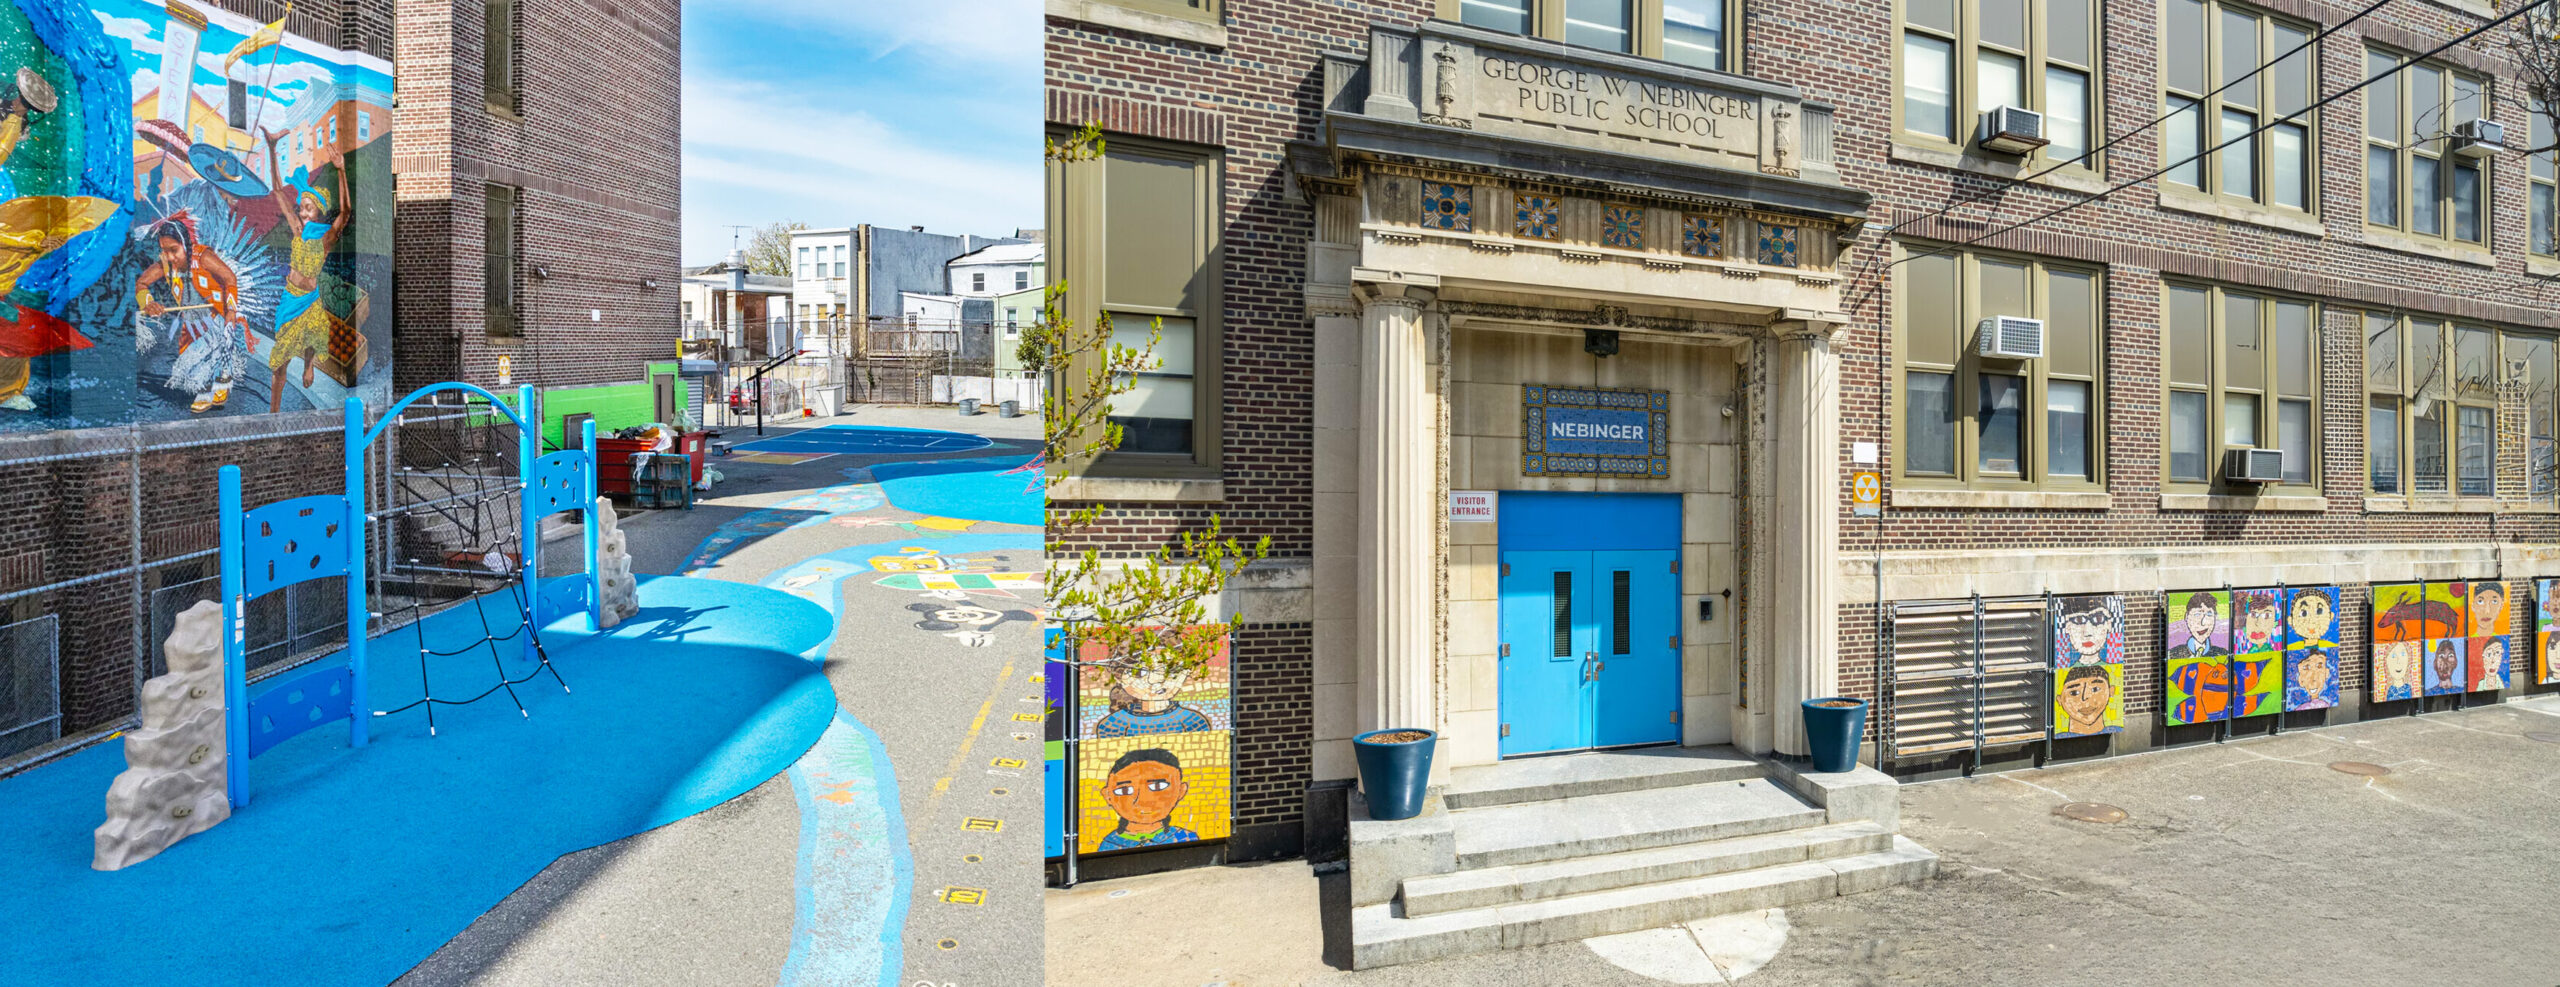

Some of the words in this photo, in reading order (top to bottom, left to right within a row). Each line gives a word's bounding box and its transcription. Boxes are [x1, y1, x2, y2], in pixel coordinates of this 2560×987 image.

[1482, 56, 1588, 93] GEORGE
[1600, 76, 1629, 98] W
[1640, 81, 1754, 121] NEBINGER
[1518, 87, 1611, 122] PUBLIC
[1624, 104, 1724, 139] SCHOOL
[1551, 422, 1644, 440] NEBINGER
[1456, 496, 1486, 506] VISITOR
[1451, 506, 1491, 516] ENTRANCE
